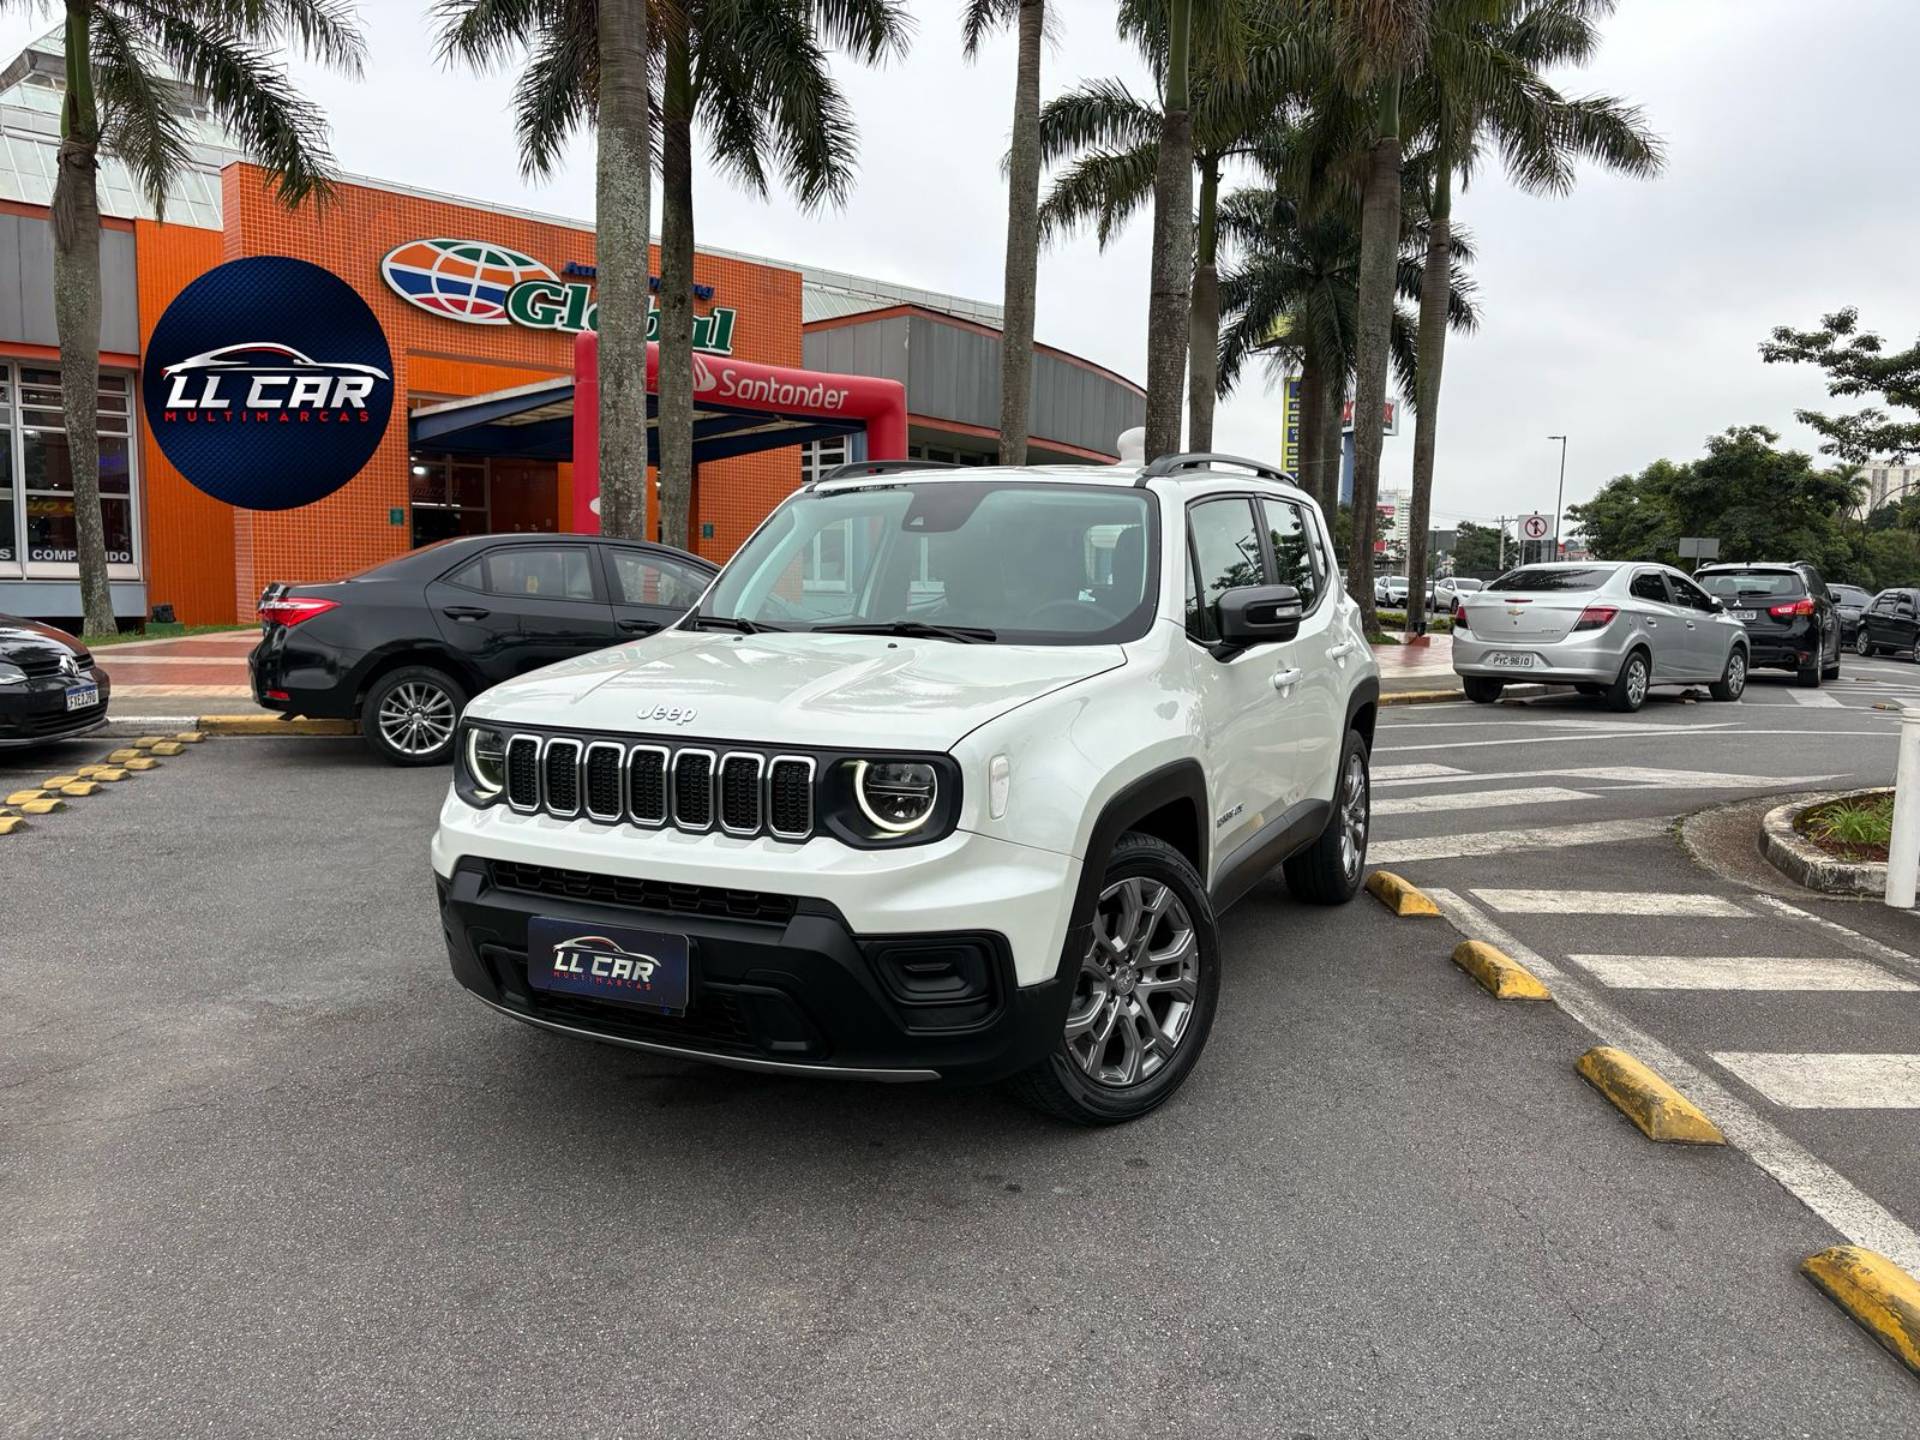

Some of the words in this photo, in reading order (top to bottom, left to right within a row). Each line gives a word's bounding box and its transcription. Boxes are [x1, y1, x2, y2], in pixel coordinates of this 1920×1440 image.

[506, 280, 736, 354] Glbl
[719, 369, 849, 409] Santander
[32, 549, 130, 562] COMPDO
[636, 704, 698, 726] Jeep
[554, 951, 583, 973] LL
[591, 955, 655, 983] CAR
[554, 971, 651, 991] MULTIMARCAS
